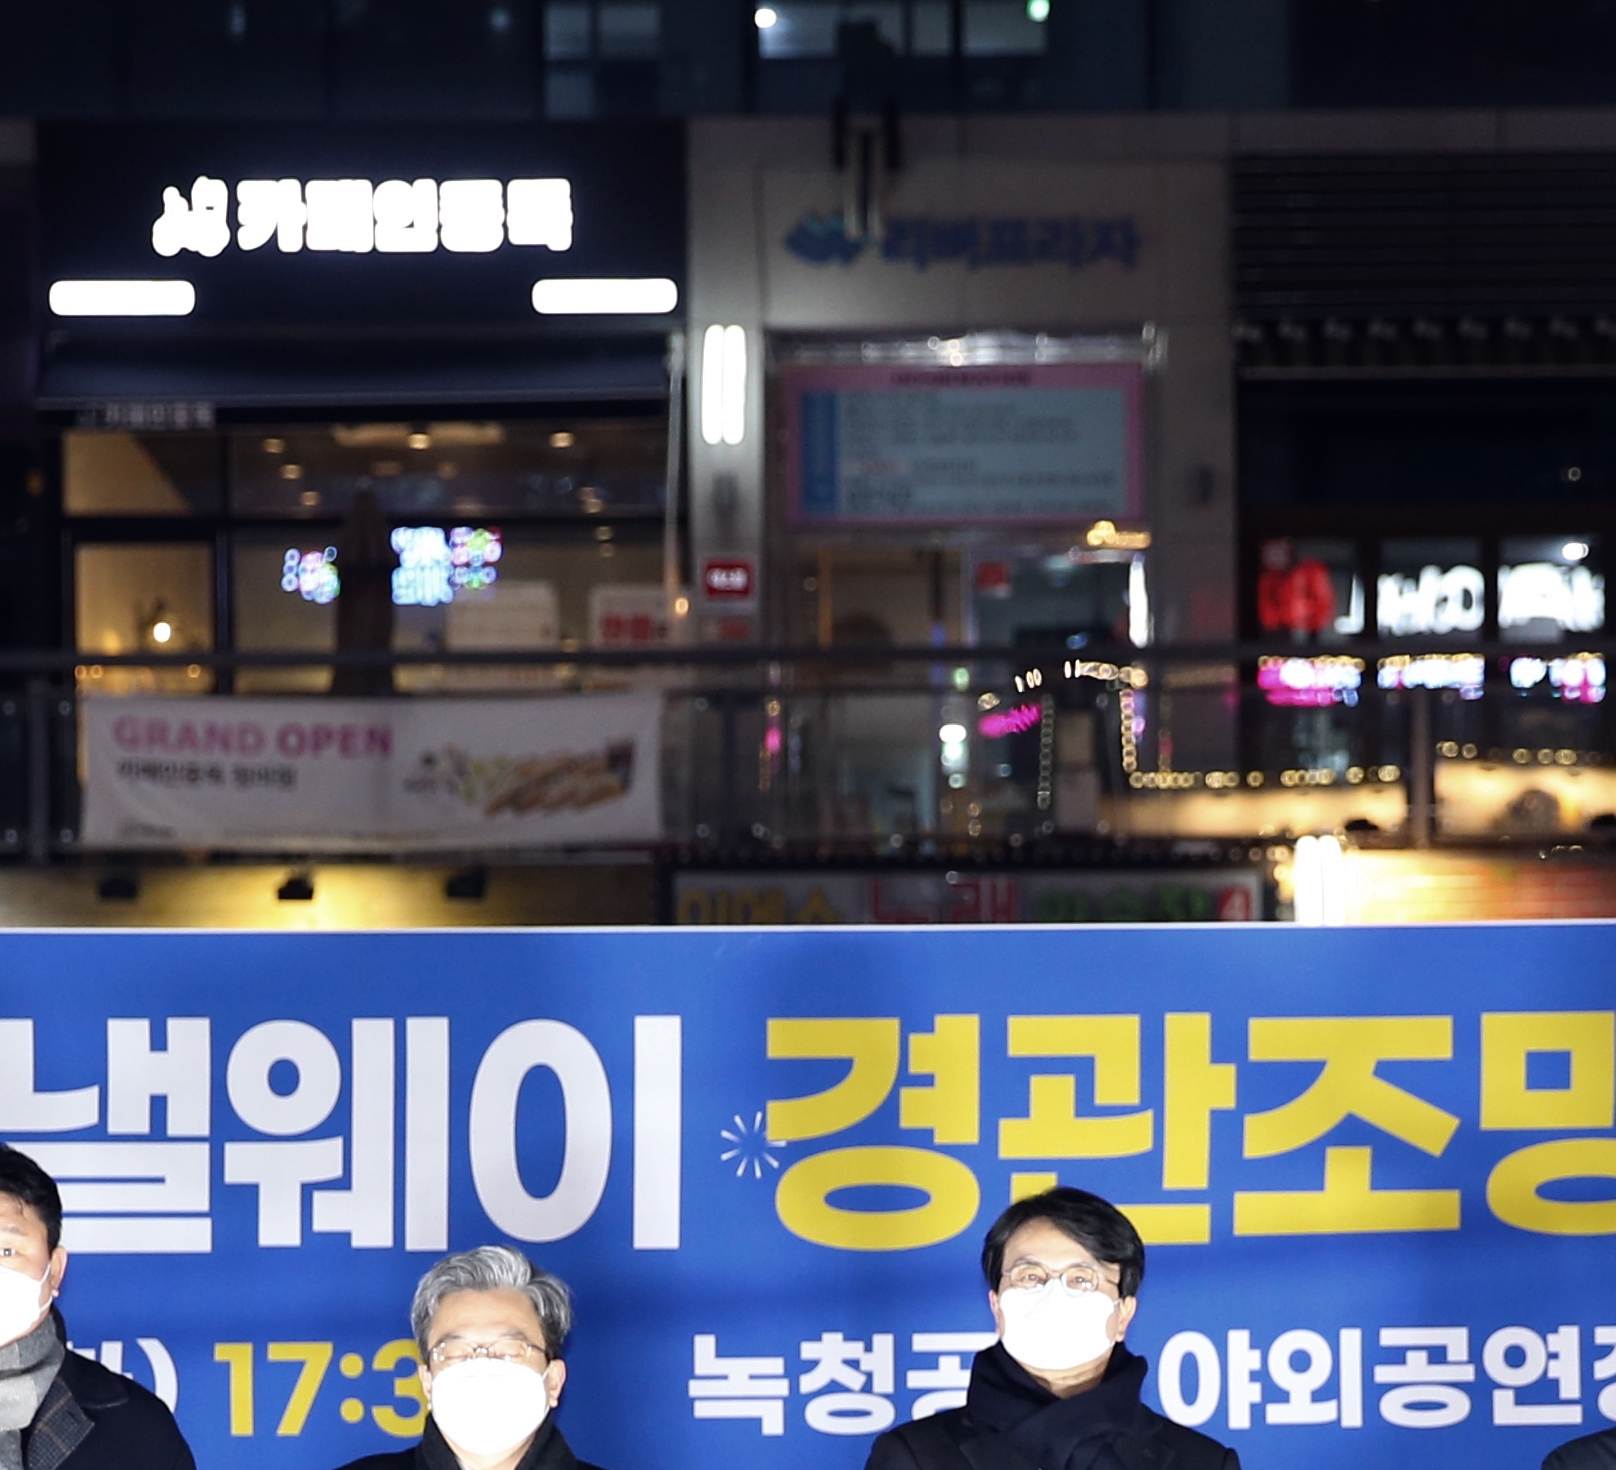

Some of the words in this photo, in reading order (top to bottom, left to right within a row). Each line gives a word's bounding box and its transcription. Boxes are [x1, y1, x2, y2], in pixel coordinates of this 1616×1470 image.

[113, 714, 267, 757] GRAND
[276, 722, 394, 760] OPEN
[213, 1340, 432, 1438] 17:3
[688, 1332, 1000, 1436] 녹청공
